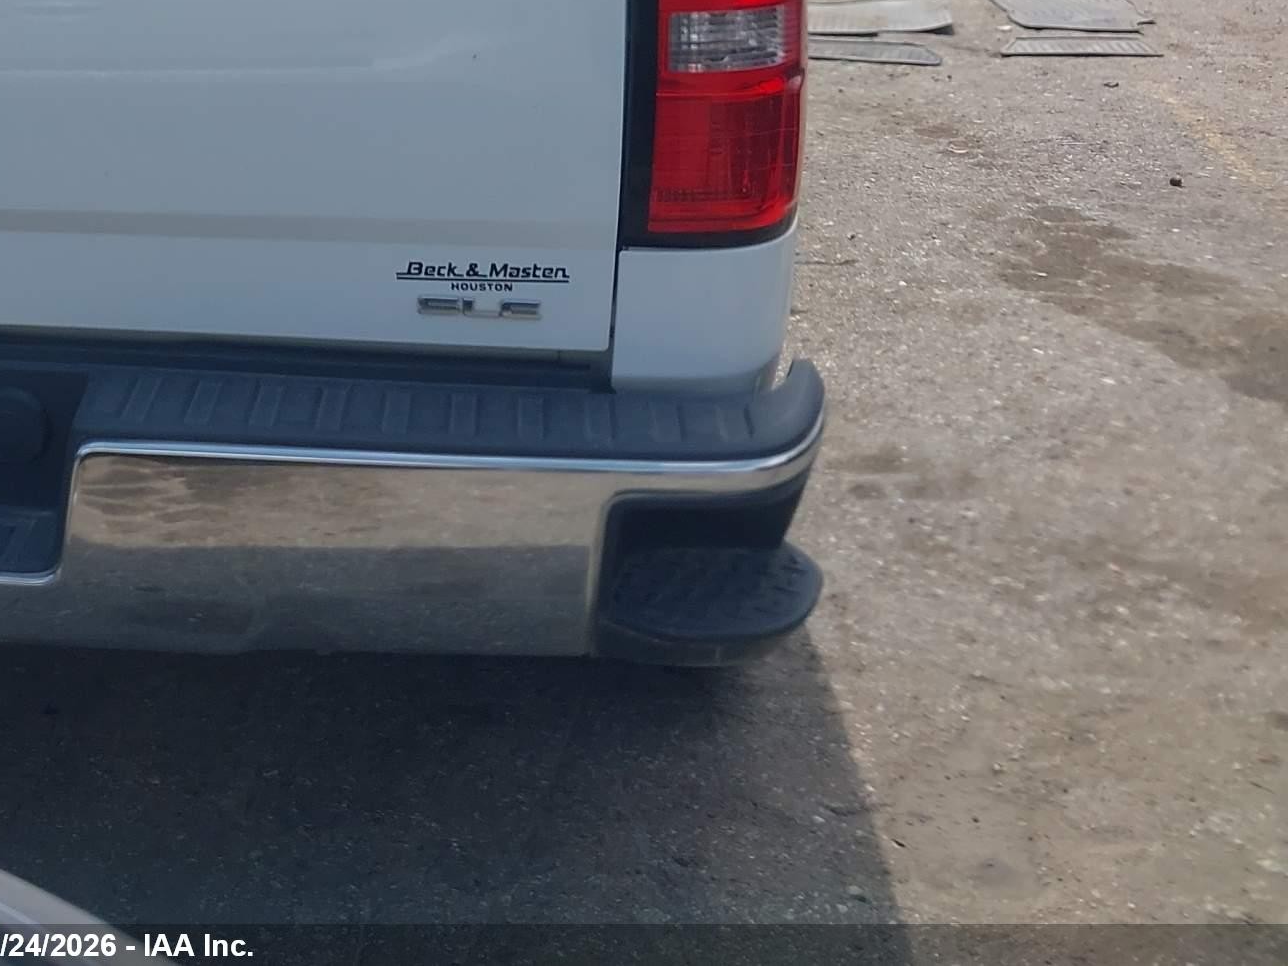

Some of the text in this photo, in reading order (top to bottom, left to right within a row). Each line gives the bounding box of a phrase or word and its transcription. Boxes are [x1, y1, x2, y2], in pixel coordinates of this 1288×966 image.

[405, 261, 569, 280] Beck & Masten
[451, 283, 514, 293] HOUSTON
